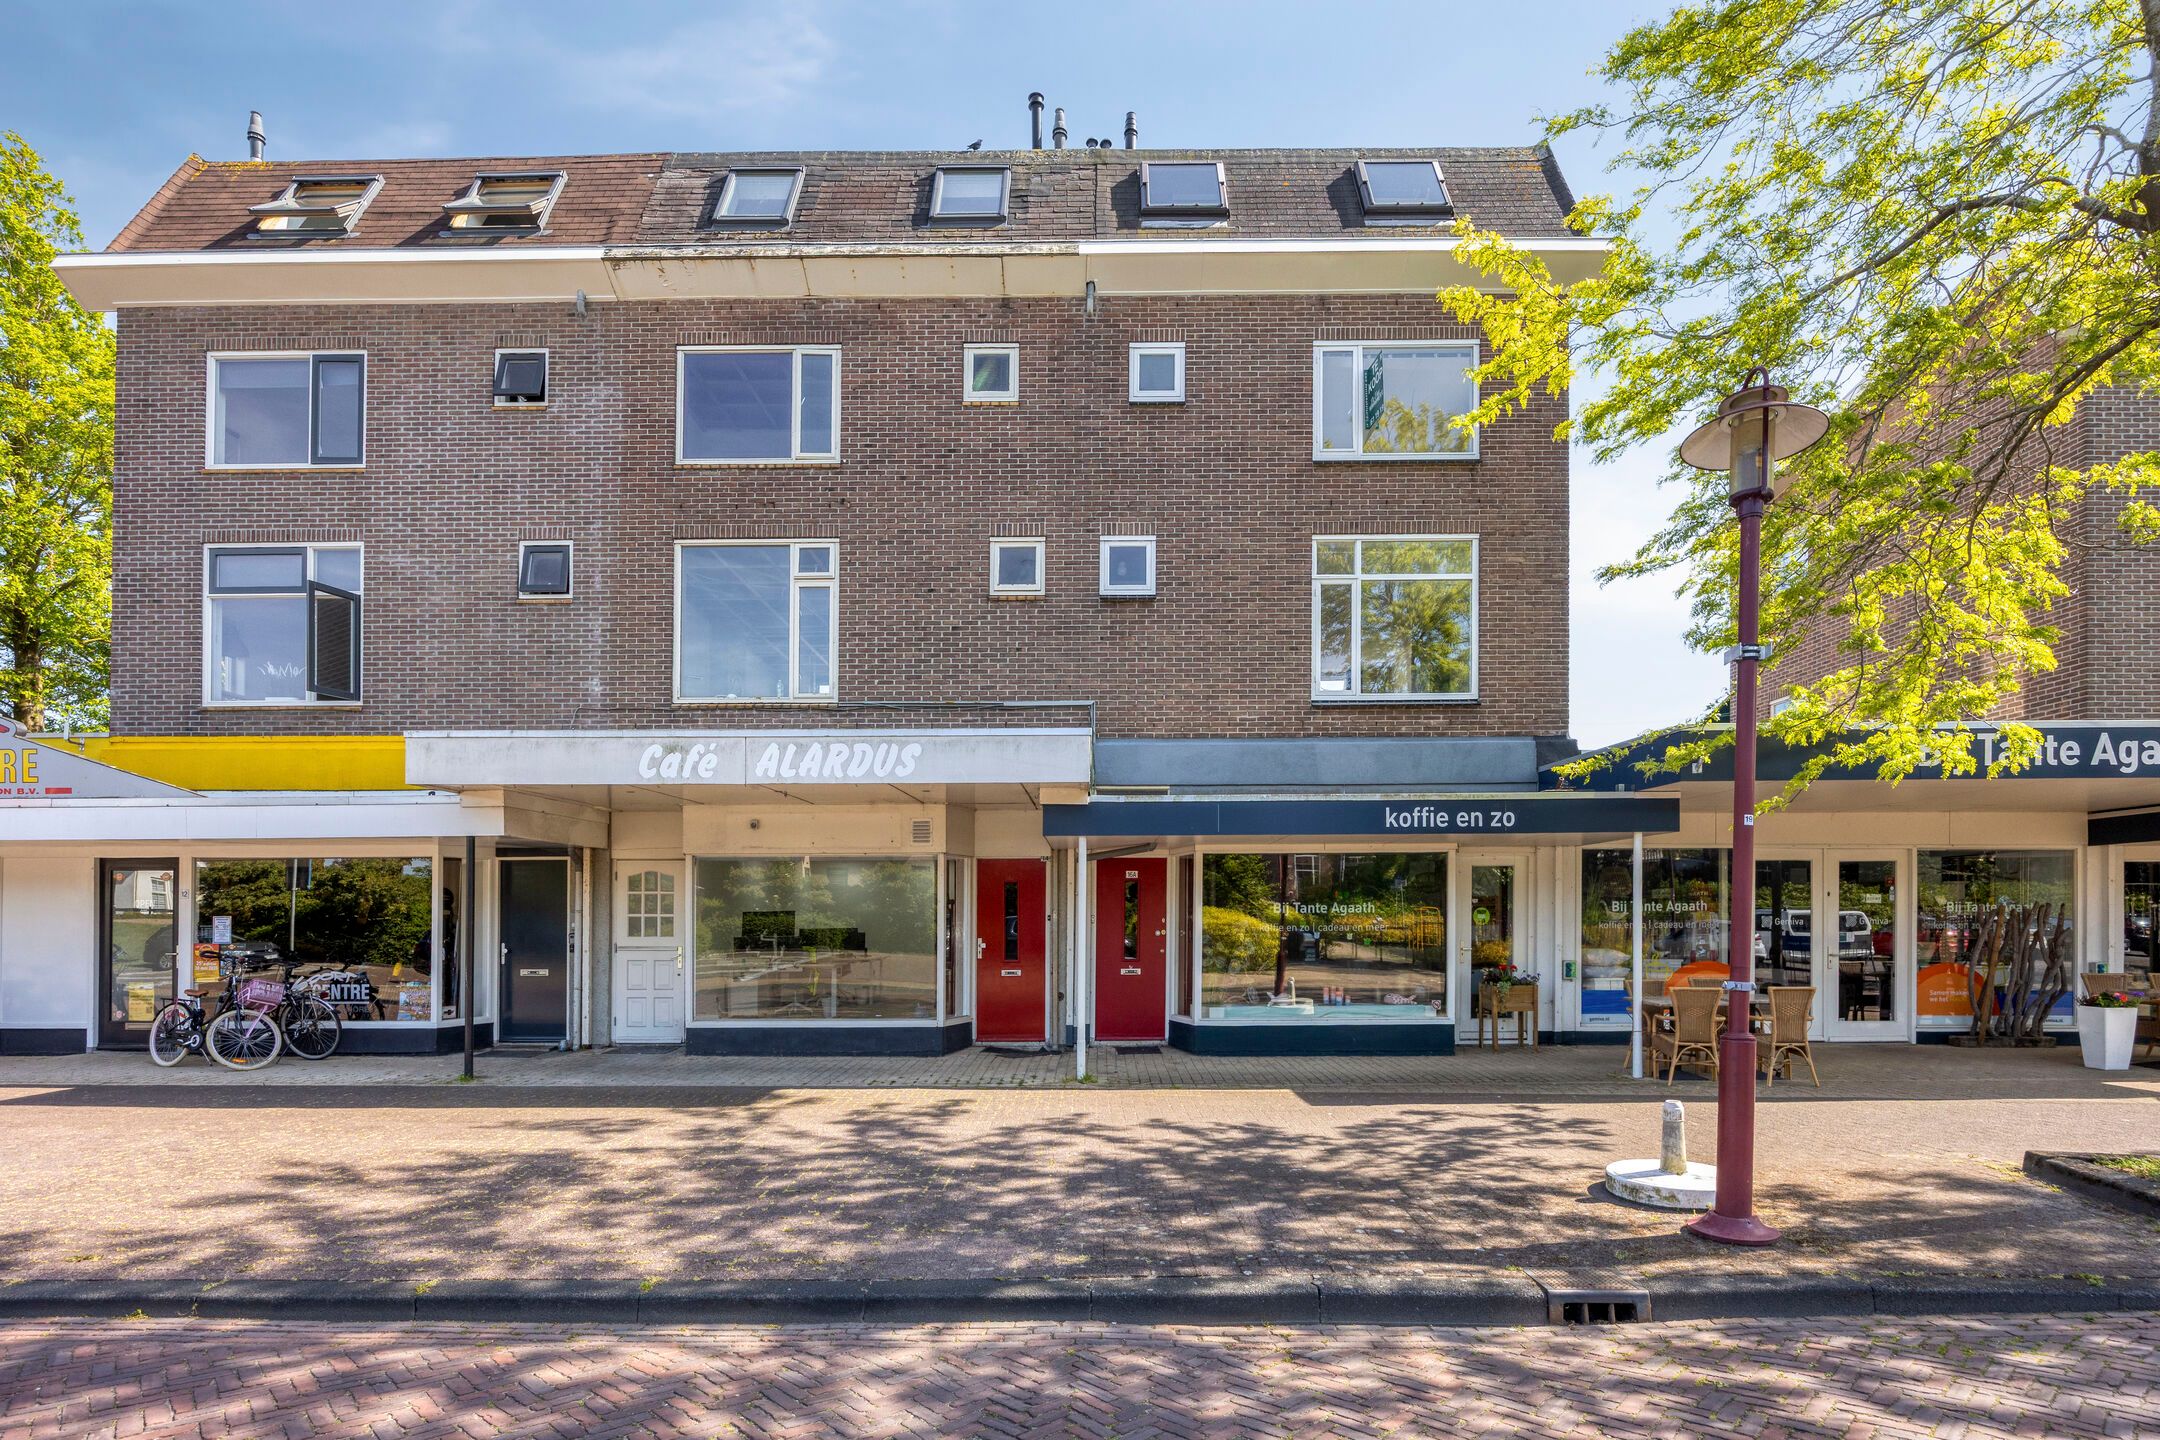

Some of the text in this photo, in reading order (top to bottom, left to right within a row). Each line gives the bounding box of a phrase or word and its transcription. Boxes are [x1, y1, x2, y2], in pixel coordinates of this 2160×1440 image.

[638, 742, 922, 779] Café ALARDUS
[2090, 732, 2160, 774] Aga
[0, 749, 39, 783] RE
[1385, 807, 1516, 828] koffie en zo
[1273, 901, 1375, 916] Bij Tante Agaath
[1612, 899, 1708, 914] Bij nte Agaath
[1946, 901, 1962, 914] Bij
[1286, 924, 1298, 932] en
[1299, 924, 1310, 932] zo
[1317, 923, 1350, 932] cadeau
[1653, 920, 1684, 929] cadeau
[1774, 917, 1804, 926] Gemiva
[1859, 917, 1889, 926] Gmiva
